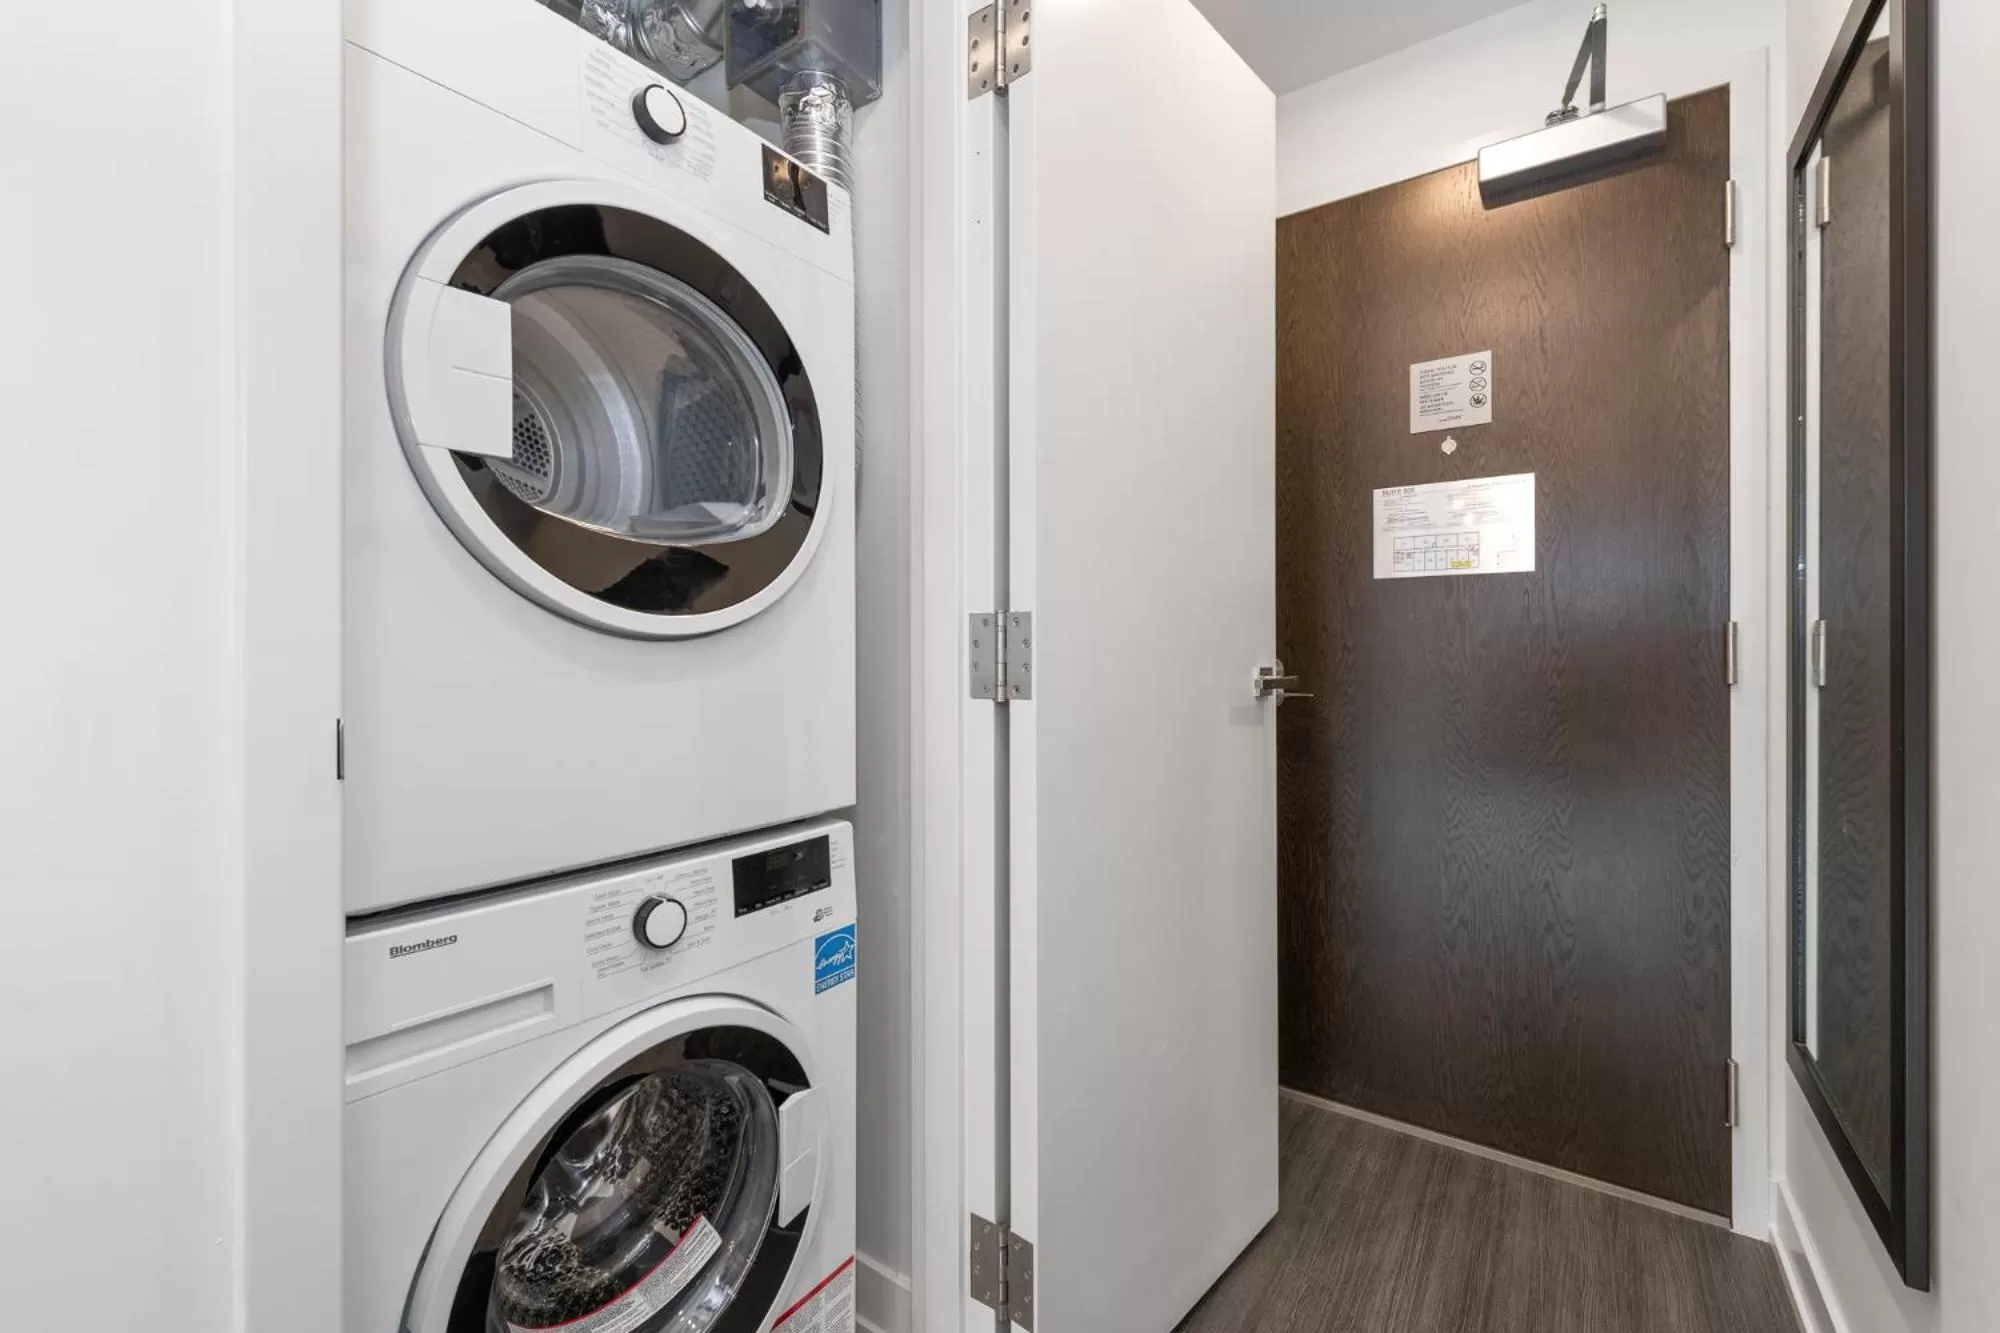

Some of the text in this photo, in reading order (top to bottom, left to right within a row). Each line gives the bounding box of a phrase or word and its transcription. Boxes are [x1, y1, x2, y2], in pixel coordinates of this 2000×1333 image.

[389, 934, 458, 957] Blomberg
[815, 968, 854, 992] ENERGY STAR
